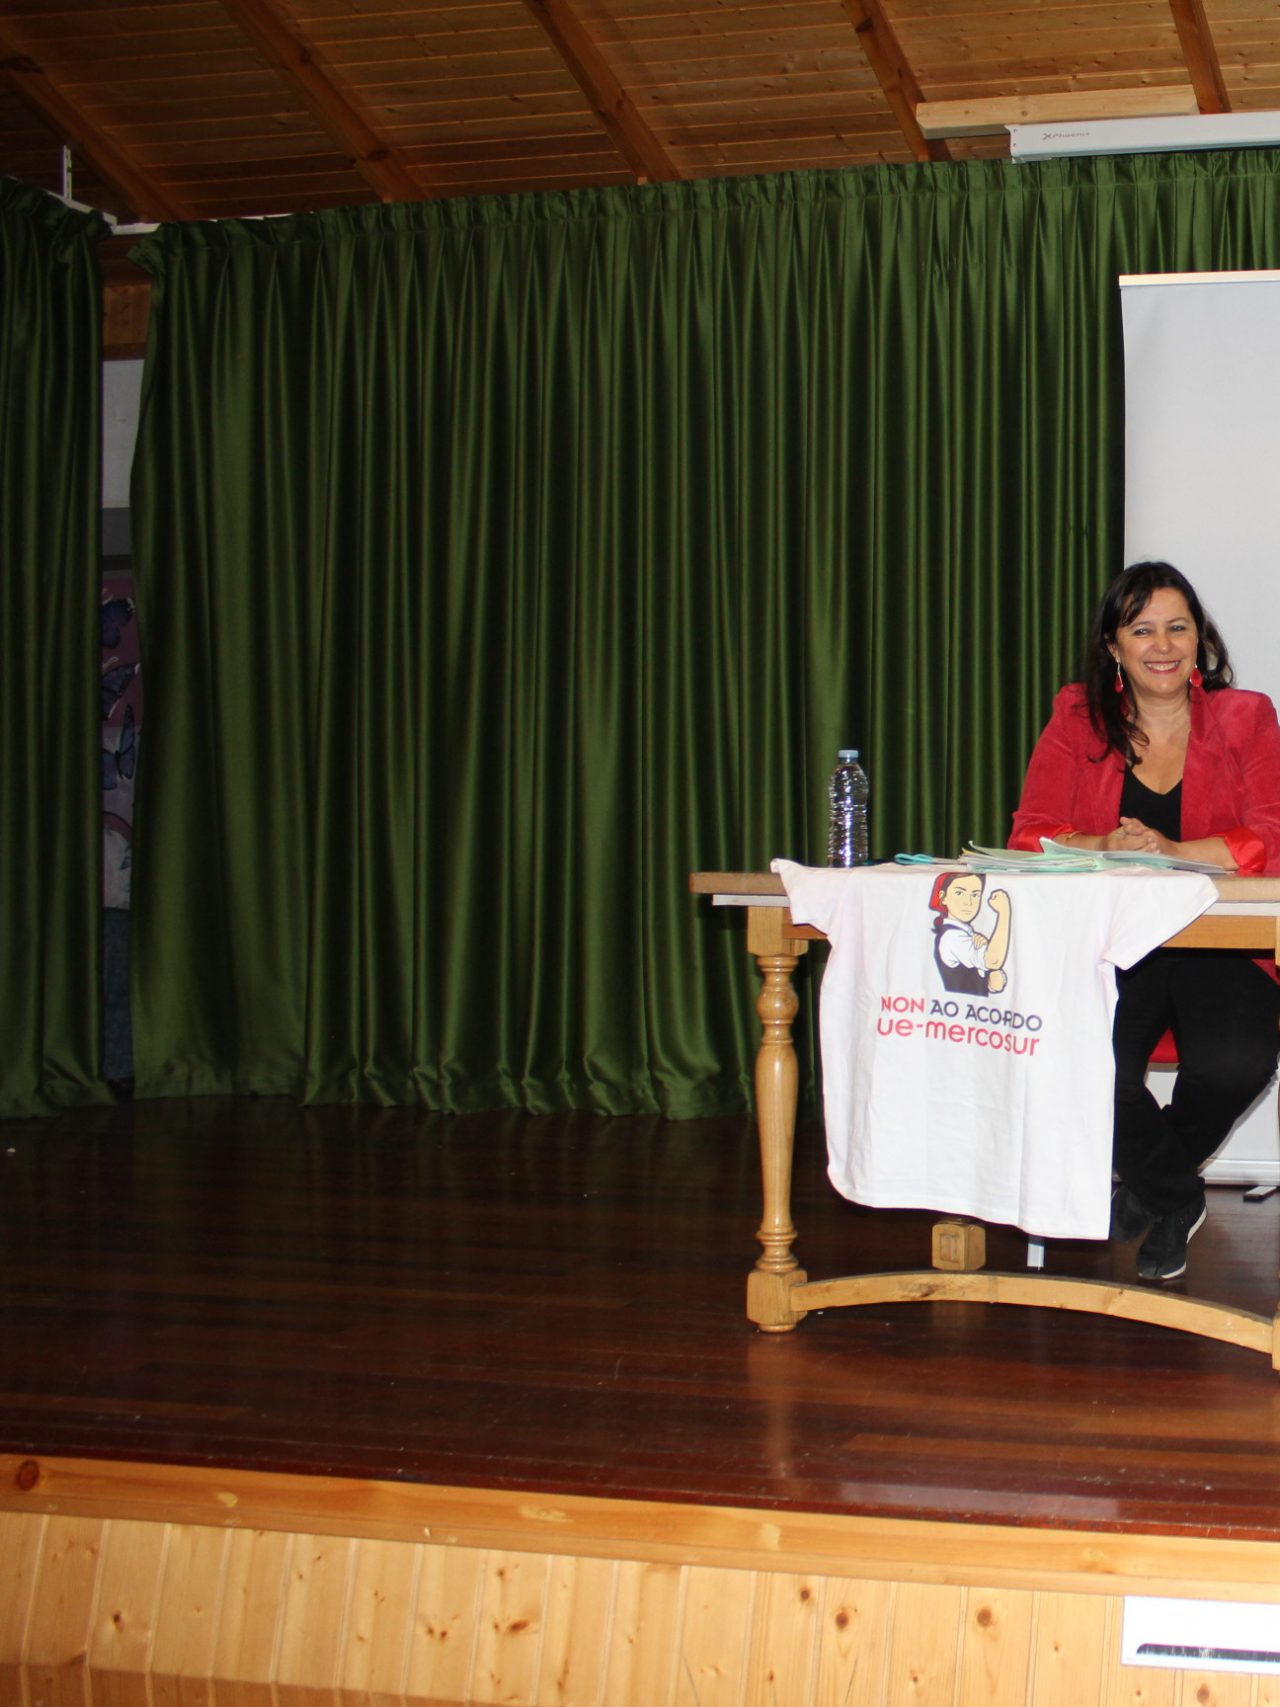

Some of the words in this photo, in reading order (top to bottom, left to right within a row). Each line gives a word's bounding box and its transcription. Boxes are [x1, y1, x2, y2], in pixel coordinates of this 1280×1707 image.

[881, 996, 925, 1013] NON
[930, 999, 960, 1018] AO
[965, 1004, 1043, 1032] ACORDO
[876, 1017, 1041, 1056] ue-mercosur
